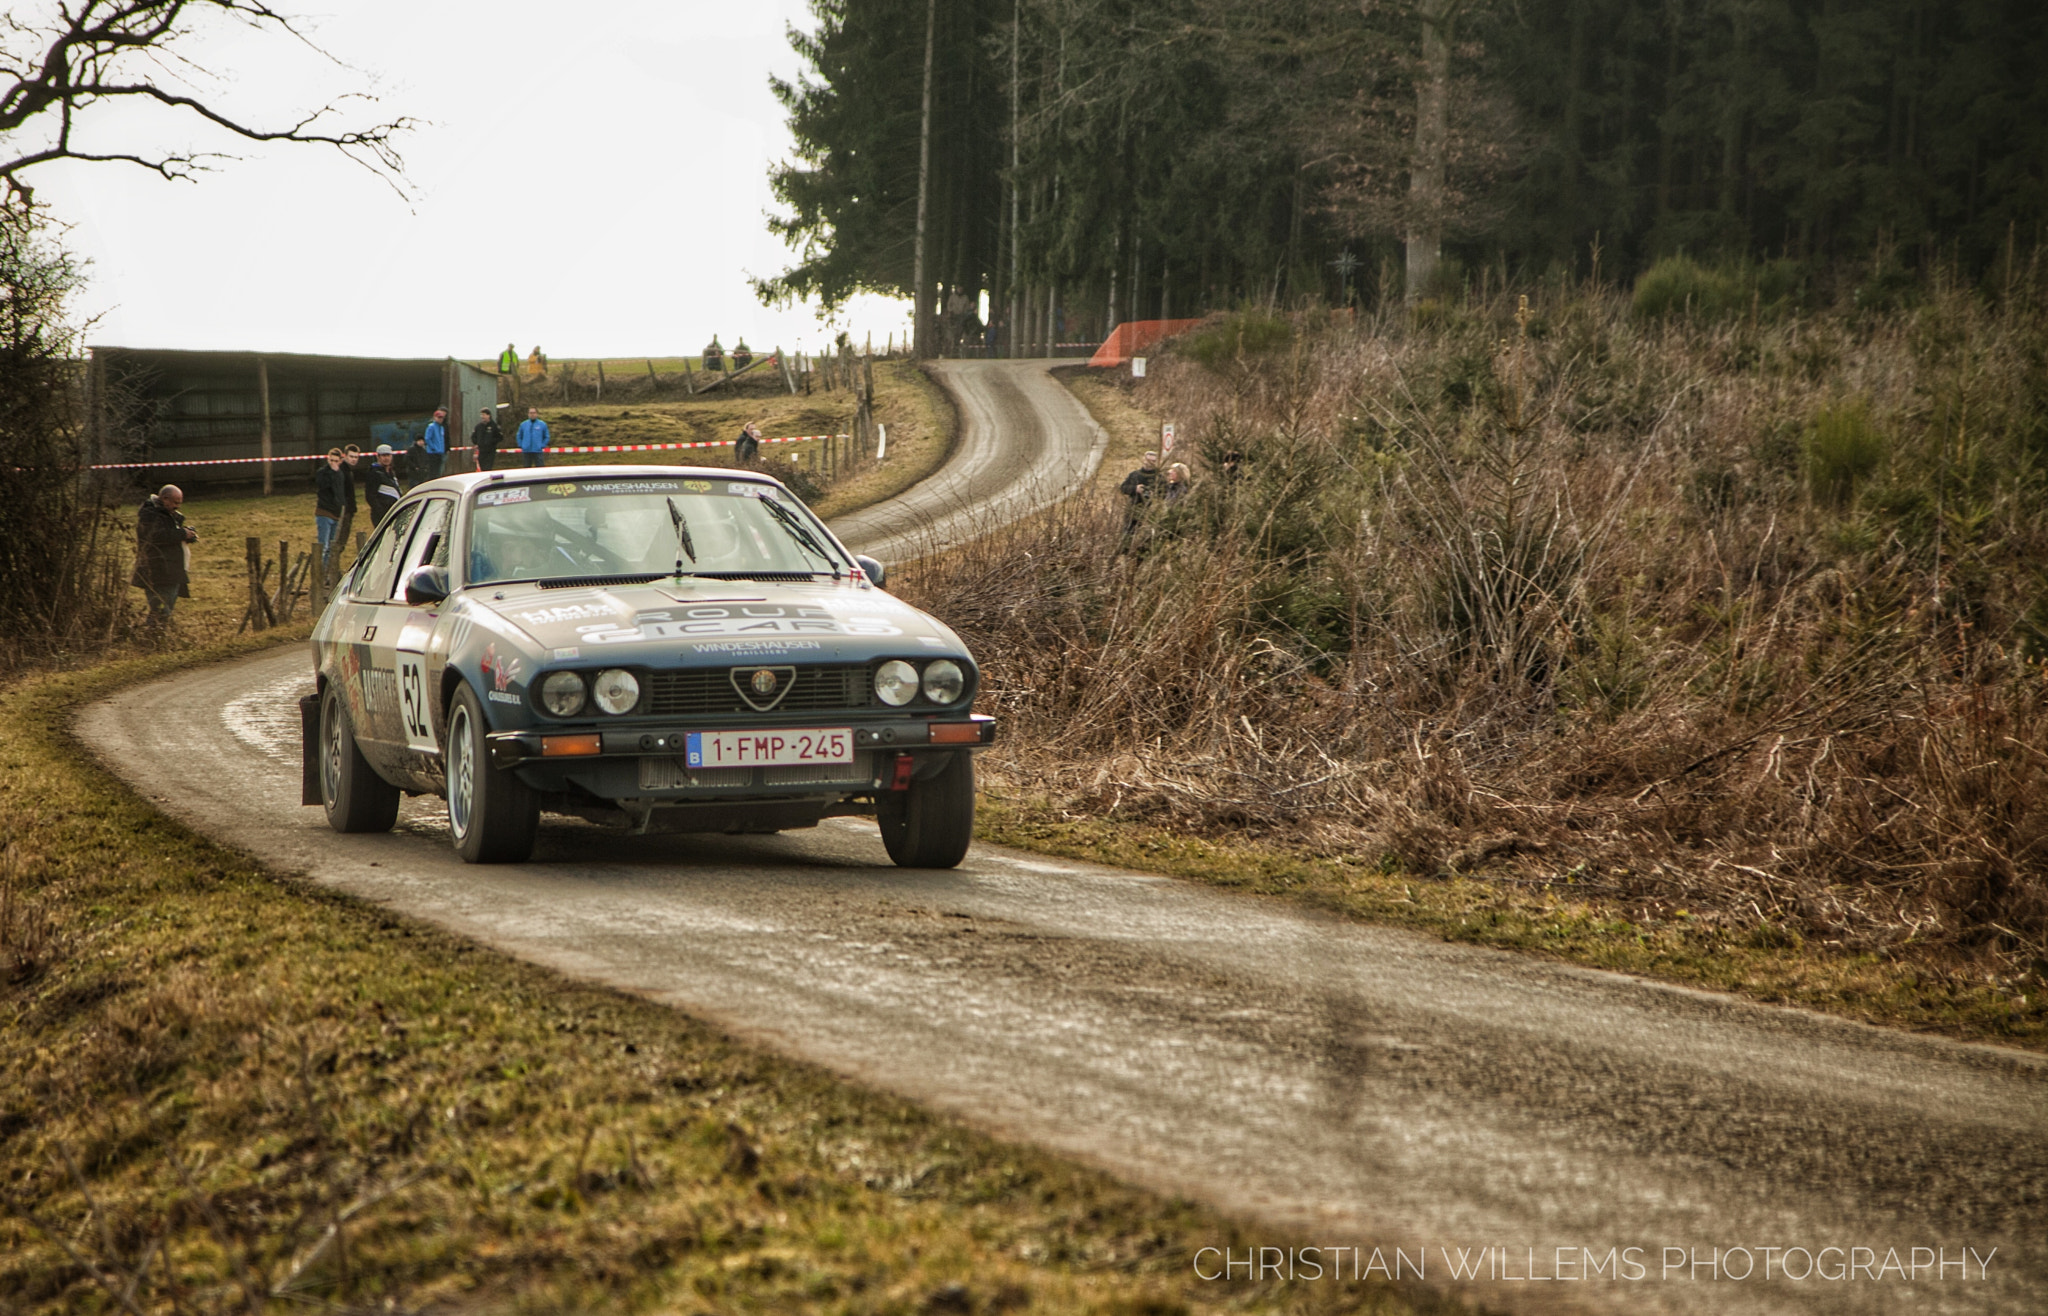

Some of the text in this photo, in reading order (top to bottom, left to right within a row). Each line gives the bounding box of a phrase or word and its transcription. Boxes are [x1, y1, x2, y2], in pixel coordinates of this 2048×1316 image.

[582, 482, 678, 491] WINDESHAUSEN
[692, 640, 821, 653] WINDESHAUSEN
[403, 664, 428, 737] 52
[712, 735, 845, 761] 1-FMP-245
[689, 752, 700, 764] B
